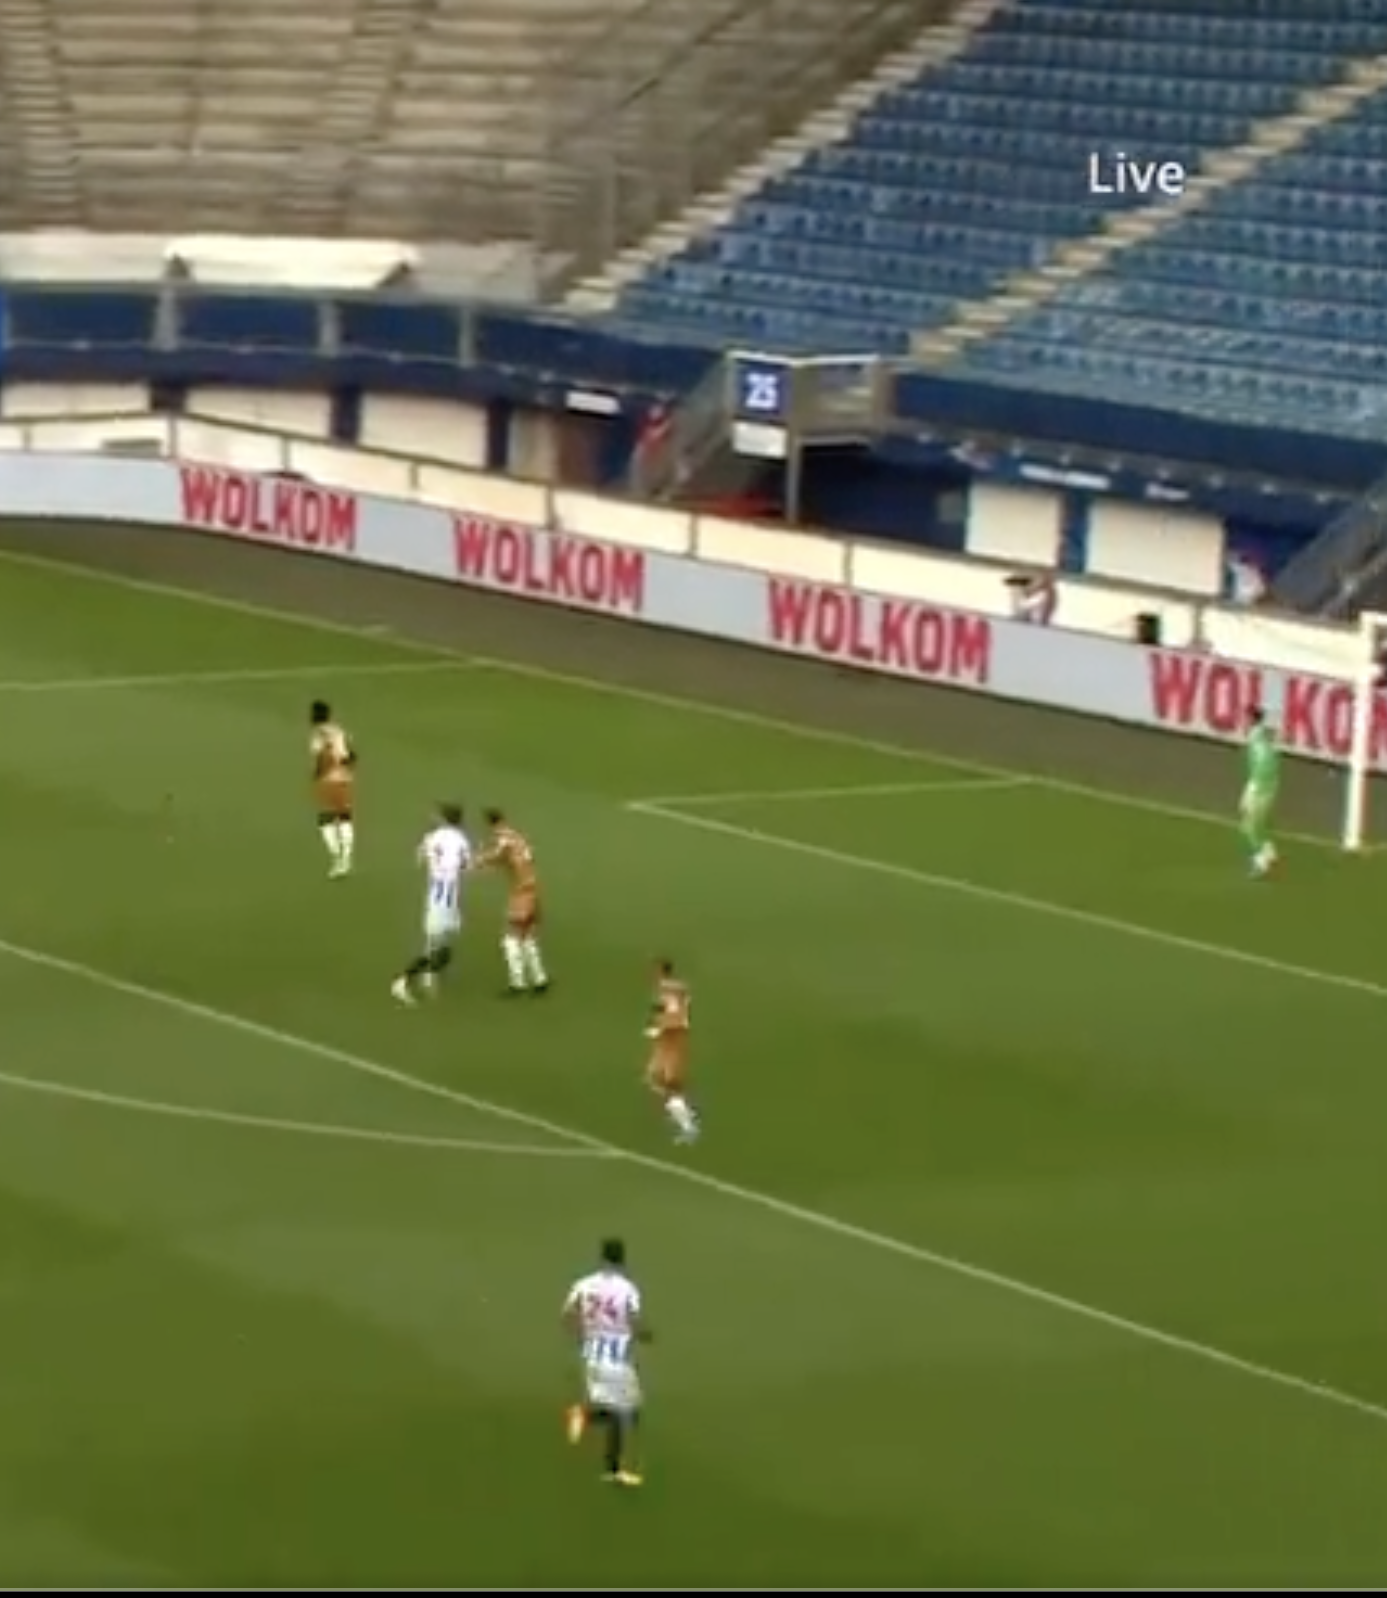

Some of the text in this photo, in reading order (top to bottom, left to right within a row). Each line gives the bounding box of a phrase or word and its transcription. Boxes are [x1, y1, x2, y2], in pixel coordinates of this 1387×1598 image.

[179, 464, 359, 552] WOLKOM
[452, 513, 646, 613] WOLKOM
[766, 576, 992, 685] WOLKOM
